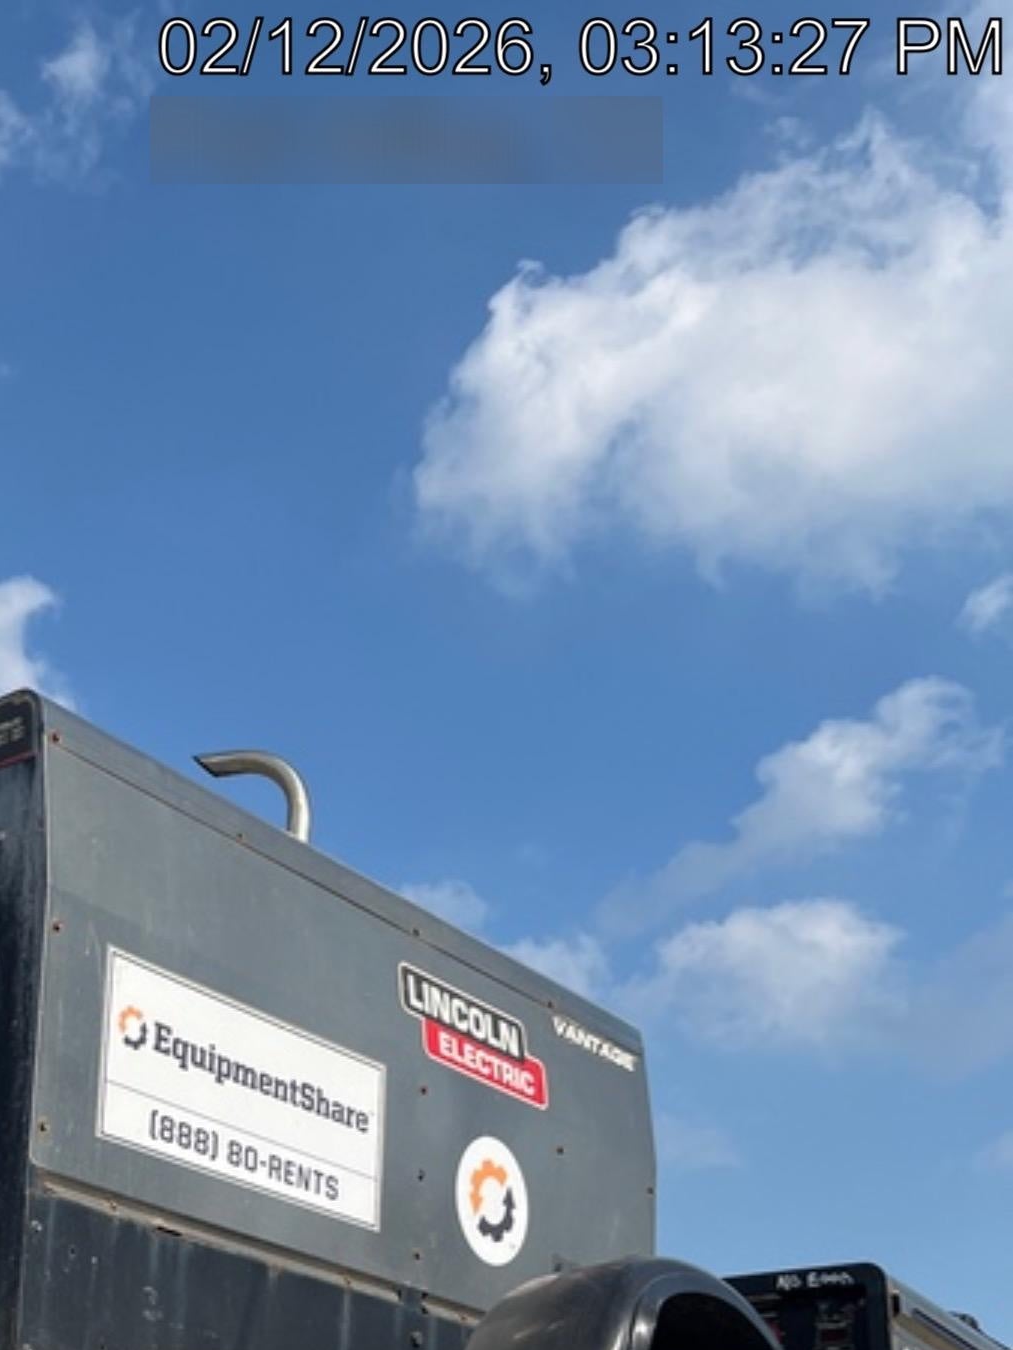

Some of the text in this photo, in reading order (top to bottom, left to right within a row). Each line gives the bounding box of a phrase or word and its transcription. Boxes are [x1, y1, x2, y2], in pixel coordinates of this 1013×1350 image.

[406, 973, 521, 1059] LINCOLN
[551, 1014, 638, 1073] VANTAGE
[152, 1020, 370, 1134] EquipmentShare
[439, 1030, 537, 1096] ELECTRIC
[149, 1108, 340, 1202] (888) 80-RENTS
